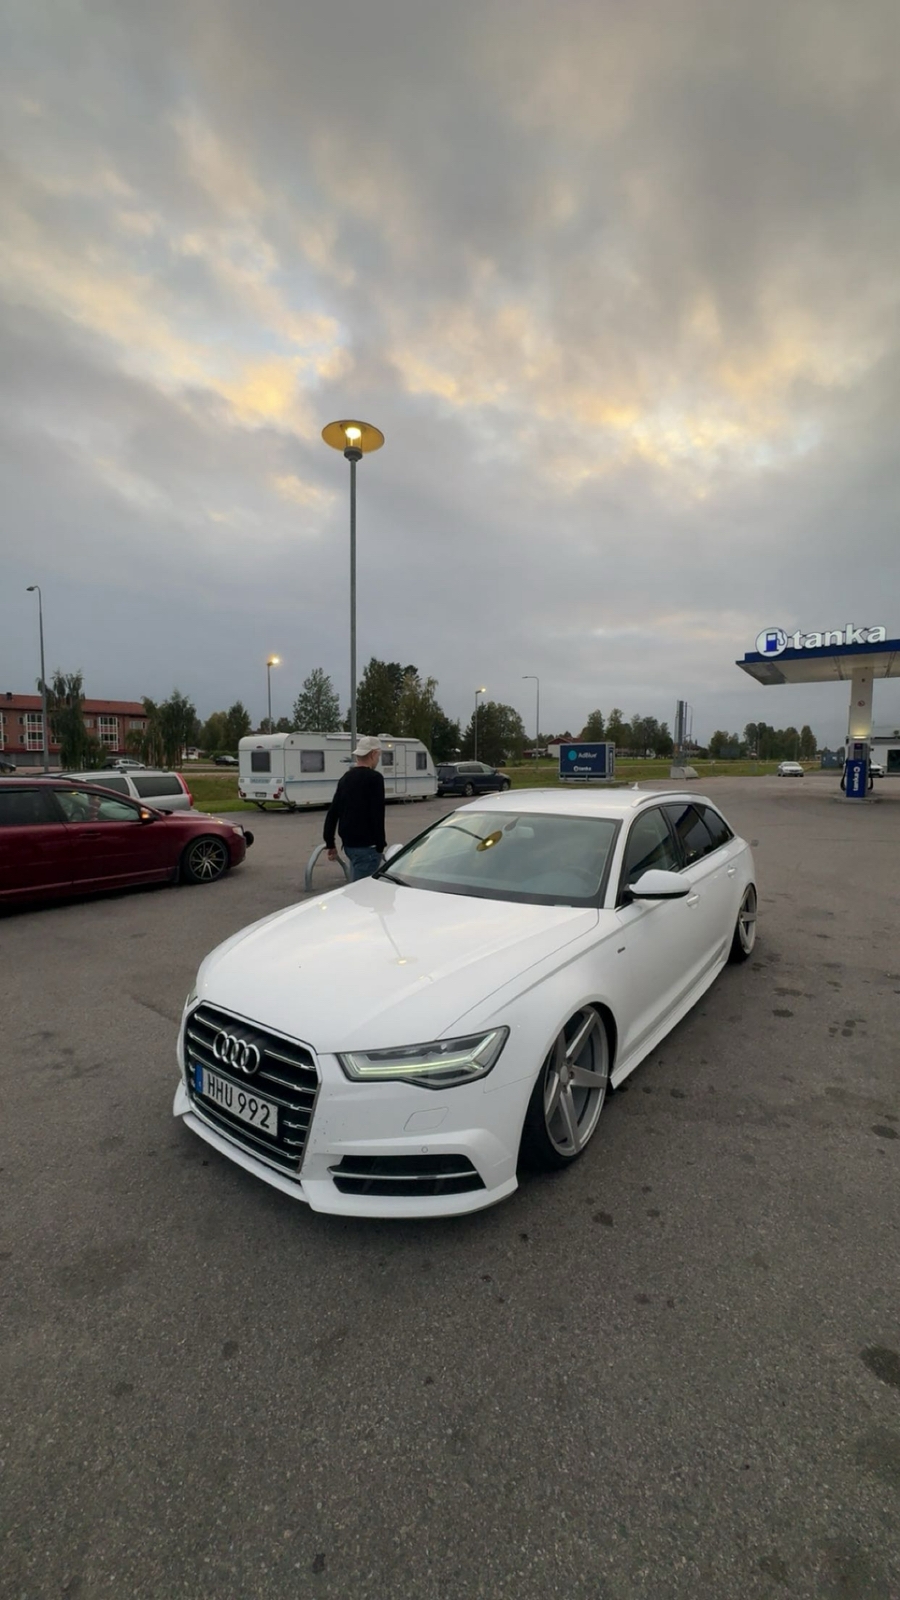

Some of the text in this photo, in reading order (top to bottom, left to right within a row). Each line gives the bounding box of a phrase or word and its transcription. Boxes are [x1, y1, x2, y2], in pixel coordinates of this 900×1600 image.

[792, 623, 887, 650] tanka
[208, 1073, 270, 1129] HHU 992
